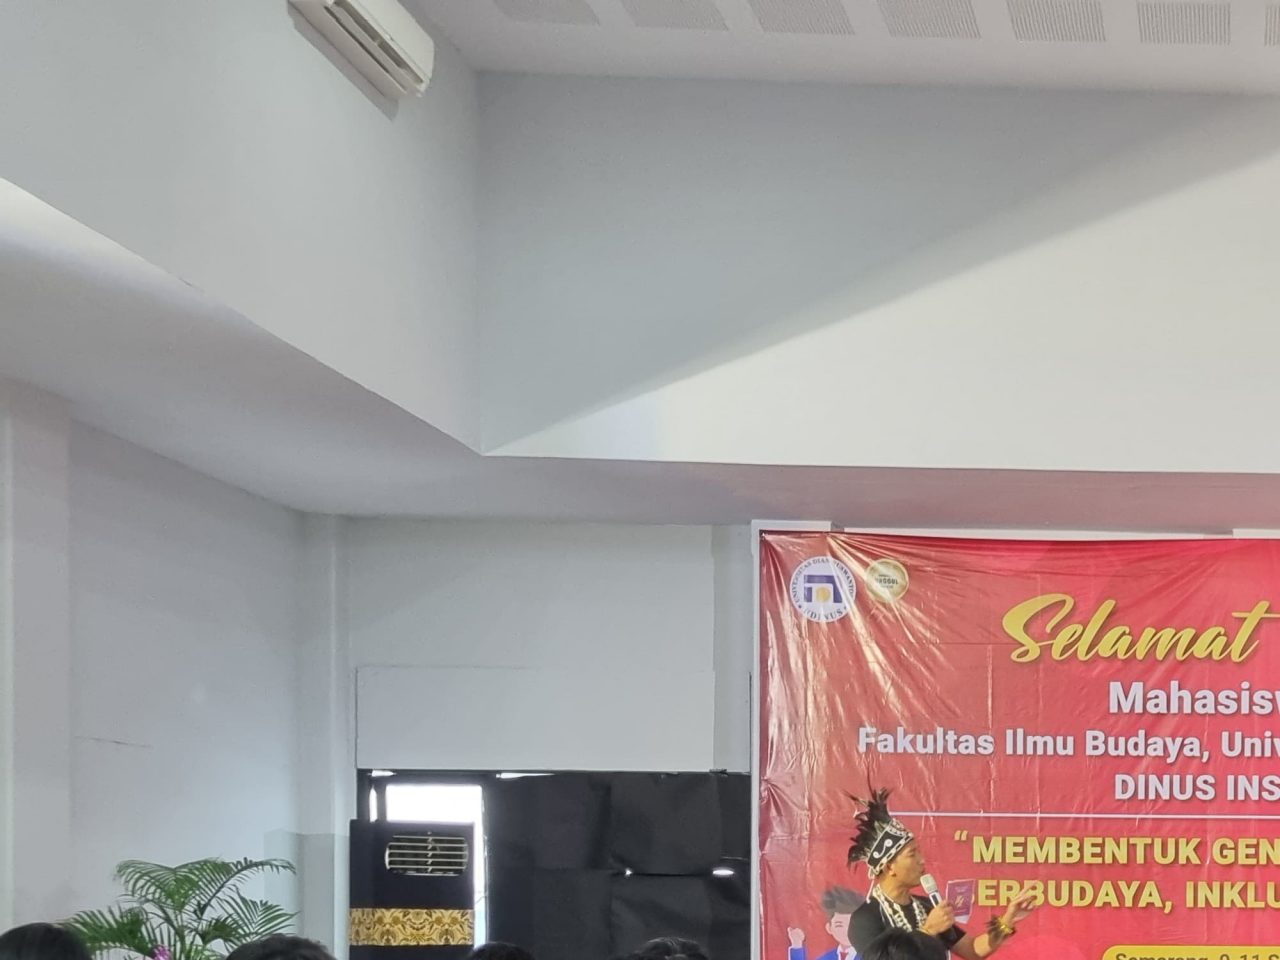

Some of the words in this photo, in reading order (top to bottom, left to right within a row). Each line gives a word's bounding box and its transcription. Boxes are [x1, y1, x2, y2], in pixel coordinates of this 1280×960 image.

[857, 727, 994, 755] Fakultas
[1005, 729, 1074, 756] Ilmu
[1084, 729, 1210, 763] Budaya,
[1115, 775, 1216, 801] DINUS
[954, 830, 1202, 865] "MEMBENTUK
[970, 880, 1173, 914] ERBUDAYA,
